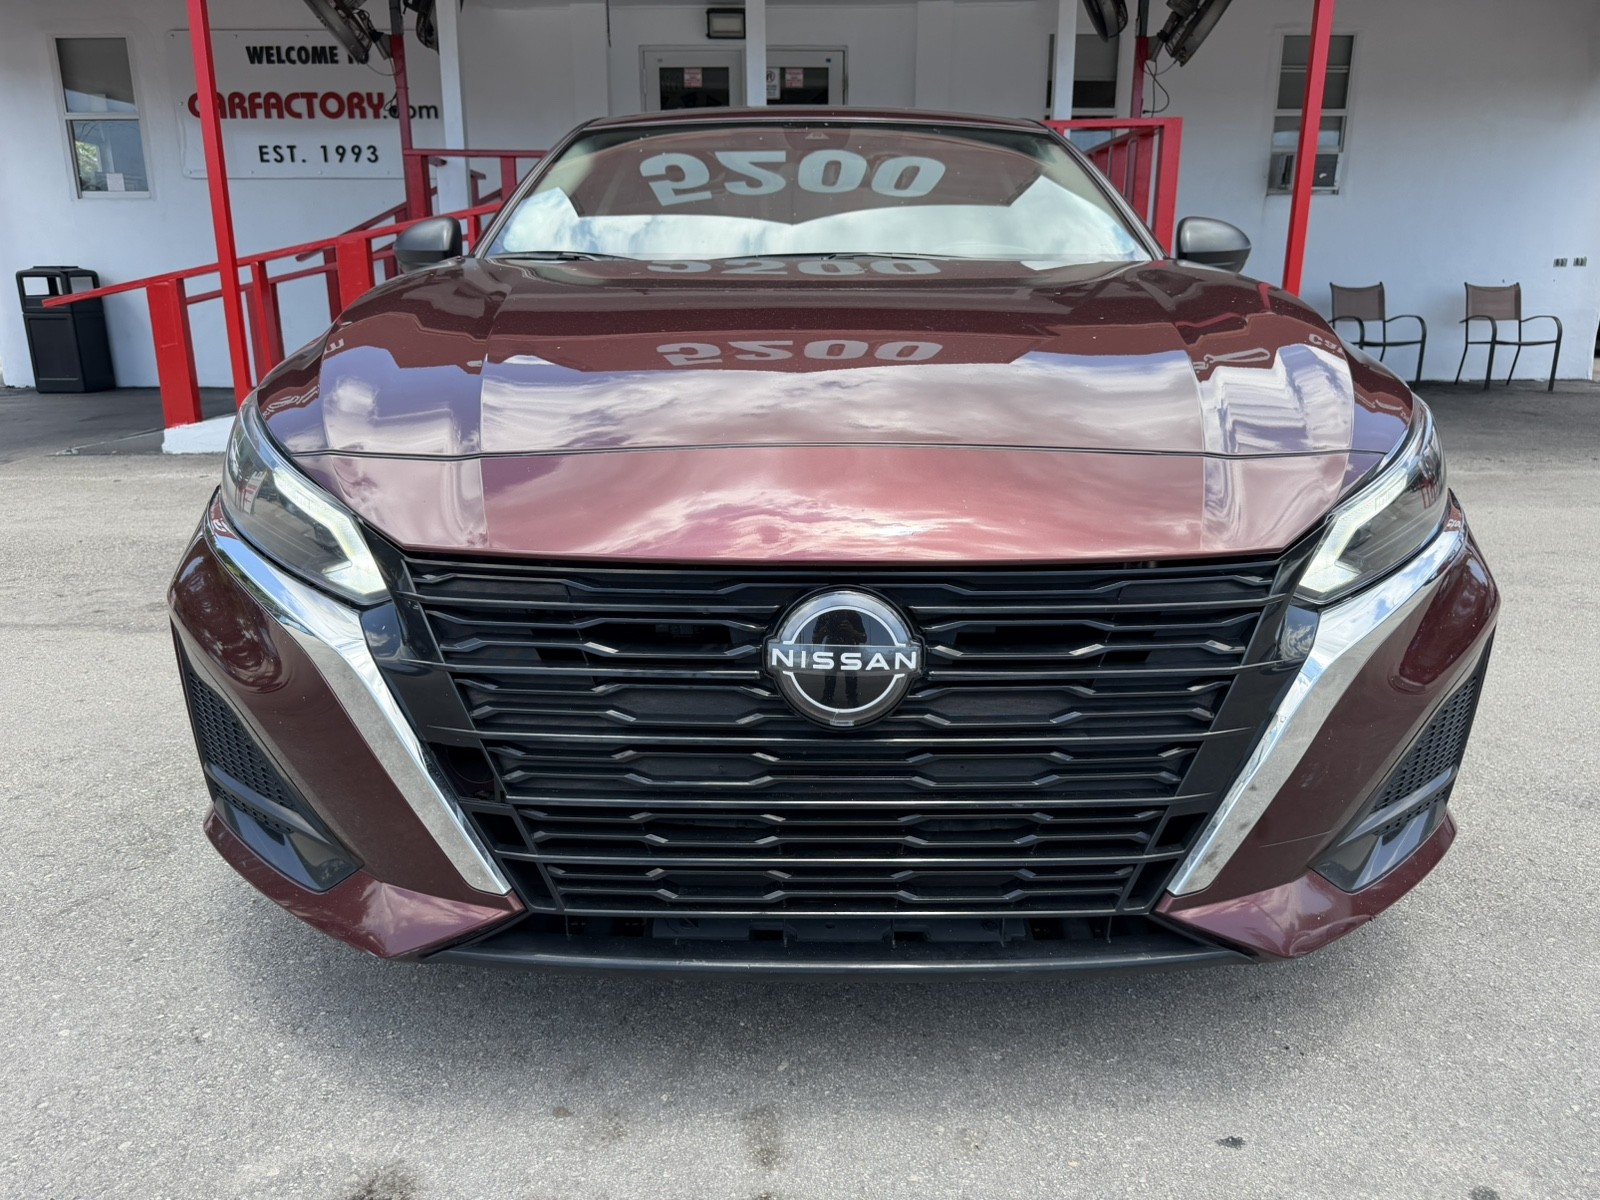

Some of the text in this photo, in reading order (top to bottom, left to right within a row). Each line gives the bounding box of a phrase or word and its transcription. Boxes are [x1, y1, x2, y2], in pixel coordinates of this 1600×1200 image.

[245, 45, 340, 65] WELCOME
[257, 145, 380, 163] EST. 1993
[771, 648, 917, 671] NISSAN
